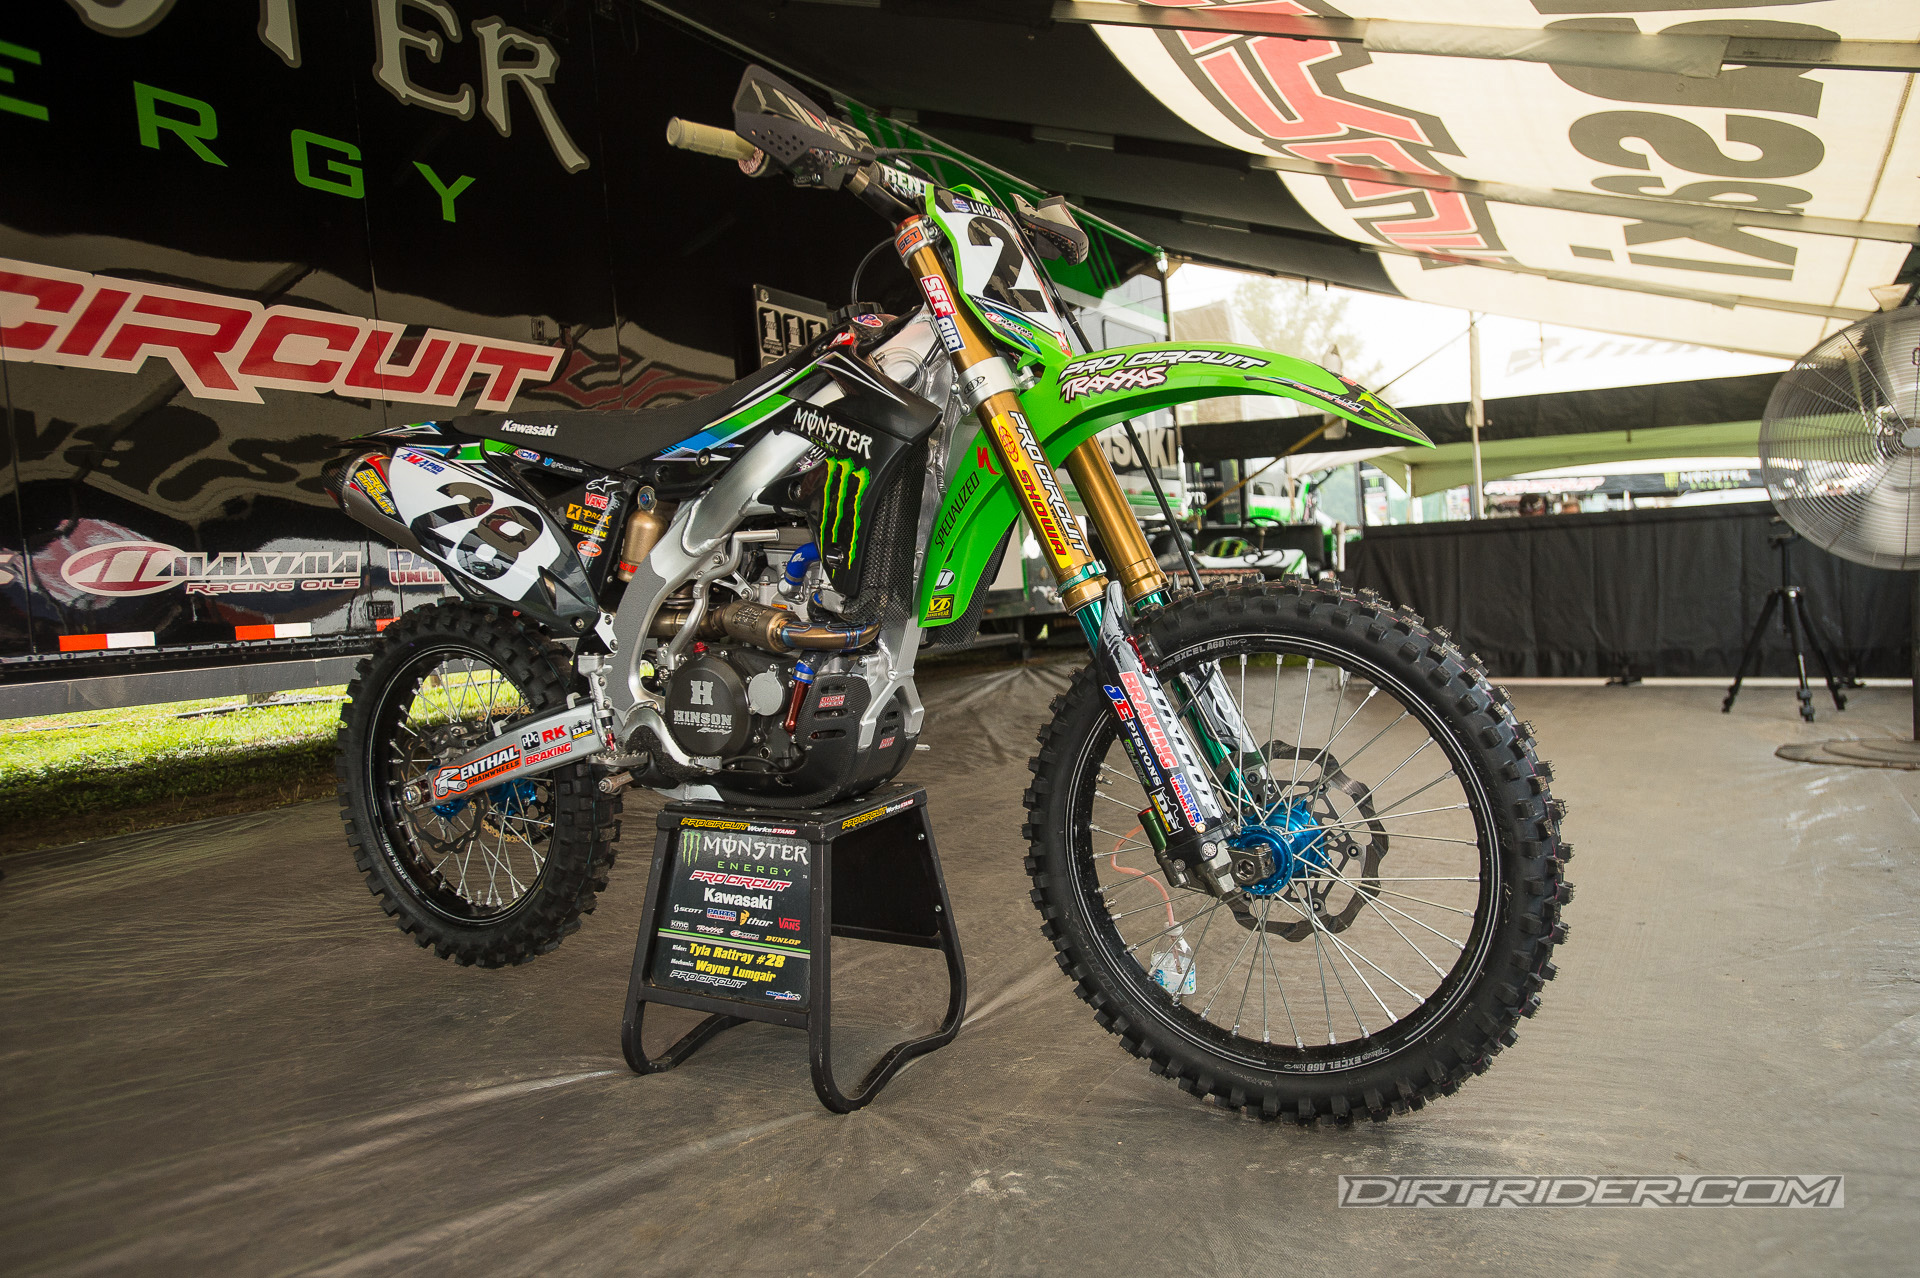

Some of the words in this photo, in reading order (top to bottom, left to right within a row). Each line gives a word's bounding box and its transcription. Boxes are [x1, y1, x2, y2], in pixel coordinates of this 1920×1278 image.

[969, 201, 1002, 221] LUCA
[966, 215, 1048, 313] 2
[924, 278, 954, 317] SFF
[0, 257, 565, 412] CIRCUIT
[1057, 354, 1126, 385] PRO
[1124, 350, 1271, 369] CIRCUIT
[1060, 366, 1170, 402] TRAXXAS
[501, 419, 559, 437] Kawasaki
[793, 407, 873, 460] MONSTER
[1101, 426, 1177, 468] SAKI
[396, 452, 430, 468] AMA
[426, 461, 445, 473] PRO
[365, 469, 388, 494] PRO
[1008, 411, 1044, 463] PRO
[1034, 463, 1091, 557] CIRCUIT
[355, 471, 396, 516] CIRCUIT
[585, 492, 608, 510] VANS
[935, 471, 980, 552] SPECIALIZED
[1016, 470, 1067, 556] SHOWA
[410, 482, 543, 580] 28
[572, 523, 607, 538] HINSON
[388, 549, 438, 571] PA
[185, 579, 295, 596] RACING
[301, 579, 361, 591] OILS
[1174, 644, 1206, 662] EXCEL
[1207, 640, 1225, 650] A60
[690, 680, 714, 706] H
[1103, 685, 1134, 721] JE
[673, 710, 732, 726] HINSON
[1119, 671, 1179, 769] BRAKING
[522, 732, 539, 748] PPG
[542, 725, 567, 743] RK
[572, 724, 591, 736] DP
[525, 743, 571, 766] BRAKING
[1126, 721, 1163, 787] PISTONS
[435, 746, 519, 797] RENTHAL
[468, 760, 520, 785] CHAINWHEELS
[1170, 777, 1196, 827] UNLIMITED
[1175, 773, 1203, 823] PARTS
[1155, 791, 1178, 830] DP
[681, 817, 706, 827] PRO
[704, 820, 750, 830] CIRCUIT
[747, 825, 772, 833] Works
[703, 835, 809, 865] MONSTER
[718, 861, 792, 876] ENERGY
[689, 870, 727, 888] PRO
[725, 874, 792, 892] CIRCUIT
[679, 906, 703, 914] SCOTT
[704, 887, 772, 910] Kawasaki
[707, 908, 737, 918] PARTS
[746, 917, 773, 927] thor
[778, 917, 800, 932] VANS
[765, 935, 801, 946] DUNLOP
[672, 944, 688, 952] Rider:
[689, 942, 712, 957] Tyla
[713, 946, 755, 964] Rattray
[756, 953, 786, 968] #28
[669, 969, 698, 982] PRO
[696, 973, 747, 988] CIRCUIT
[695, 959, 731, 976] Wayne
[732, 965, 776, 983] Lumgair
[1306, 1062, 1326, 1072] A60
[1327, 1056, 1362, 1071] EXCEL
